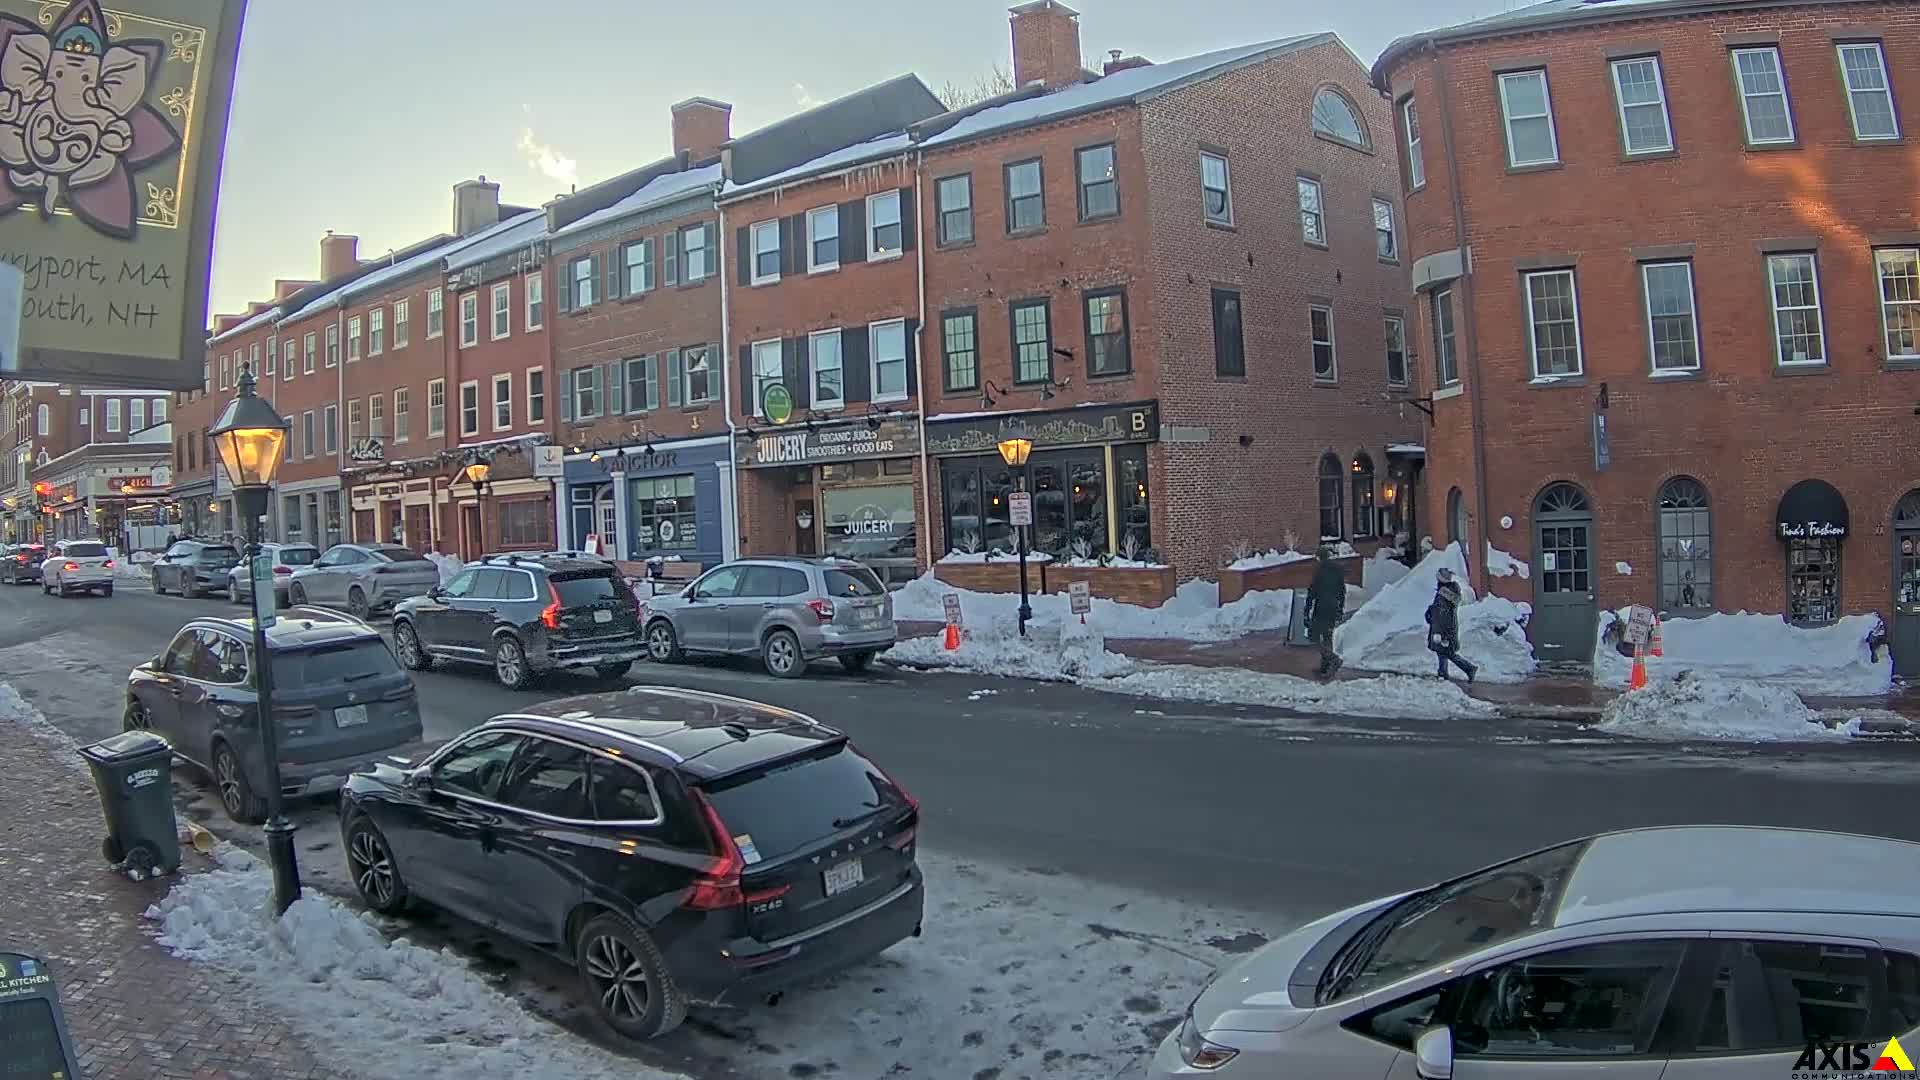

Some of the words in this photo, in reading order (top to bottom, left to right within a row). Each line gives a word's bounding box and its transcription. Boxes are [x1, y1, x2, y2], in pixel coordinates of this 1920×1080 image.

[118, 258, 171, 288] MA
[107, 301, 159, 328] NH
[1132, 412, 1145, 431] B
[819, 431, 851, 443] ORGANIC
[852, 430, 878, 441] JUICES
[757, 433, 807, 463] JUICERY
[806, 444, 847, 457] SMOOTHIES
[852, 442, 874, 454] GOOD
[876, 440, 893, 452] EATS
[611, 451, 677, 473] ANCHOR
[844, 520, 894, 534] JUICERY
[811, 831, 884, 865] VOLVO
[9, 975, 49, 988] KITCHEN
